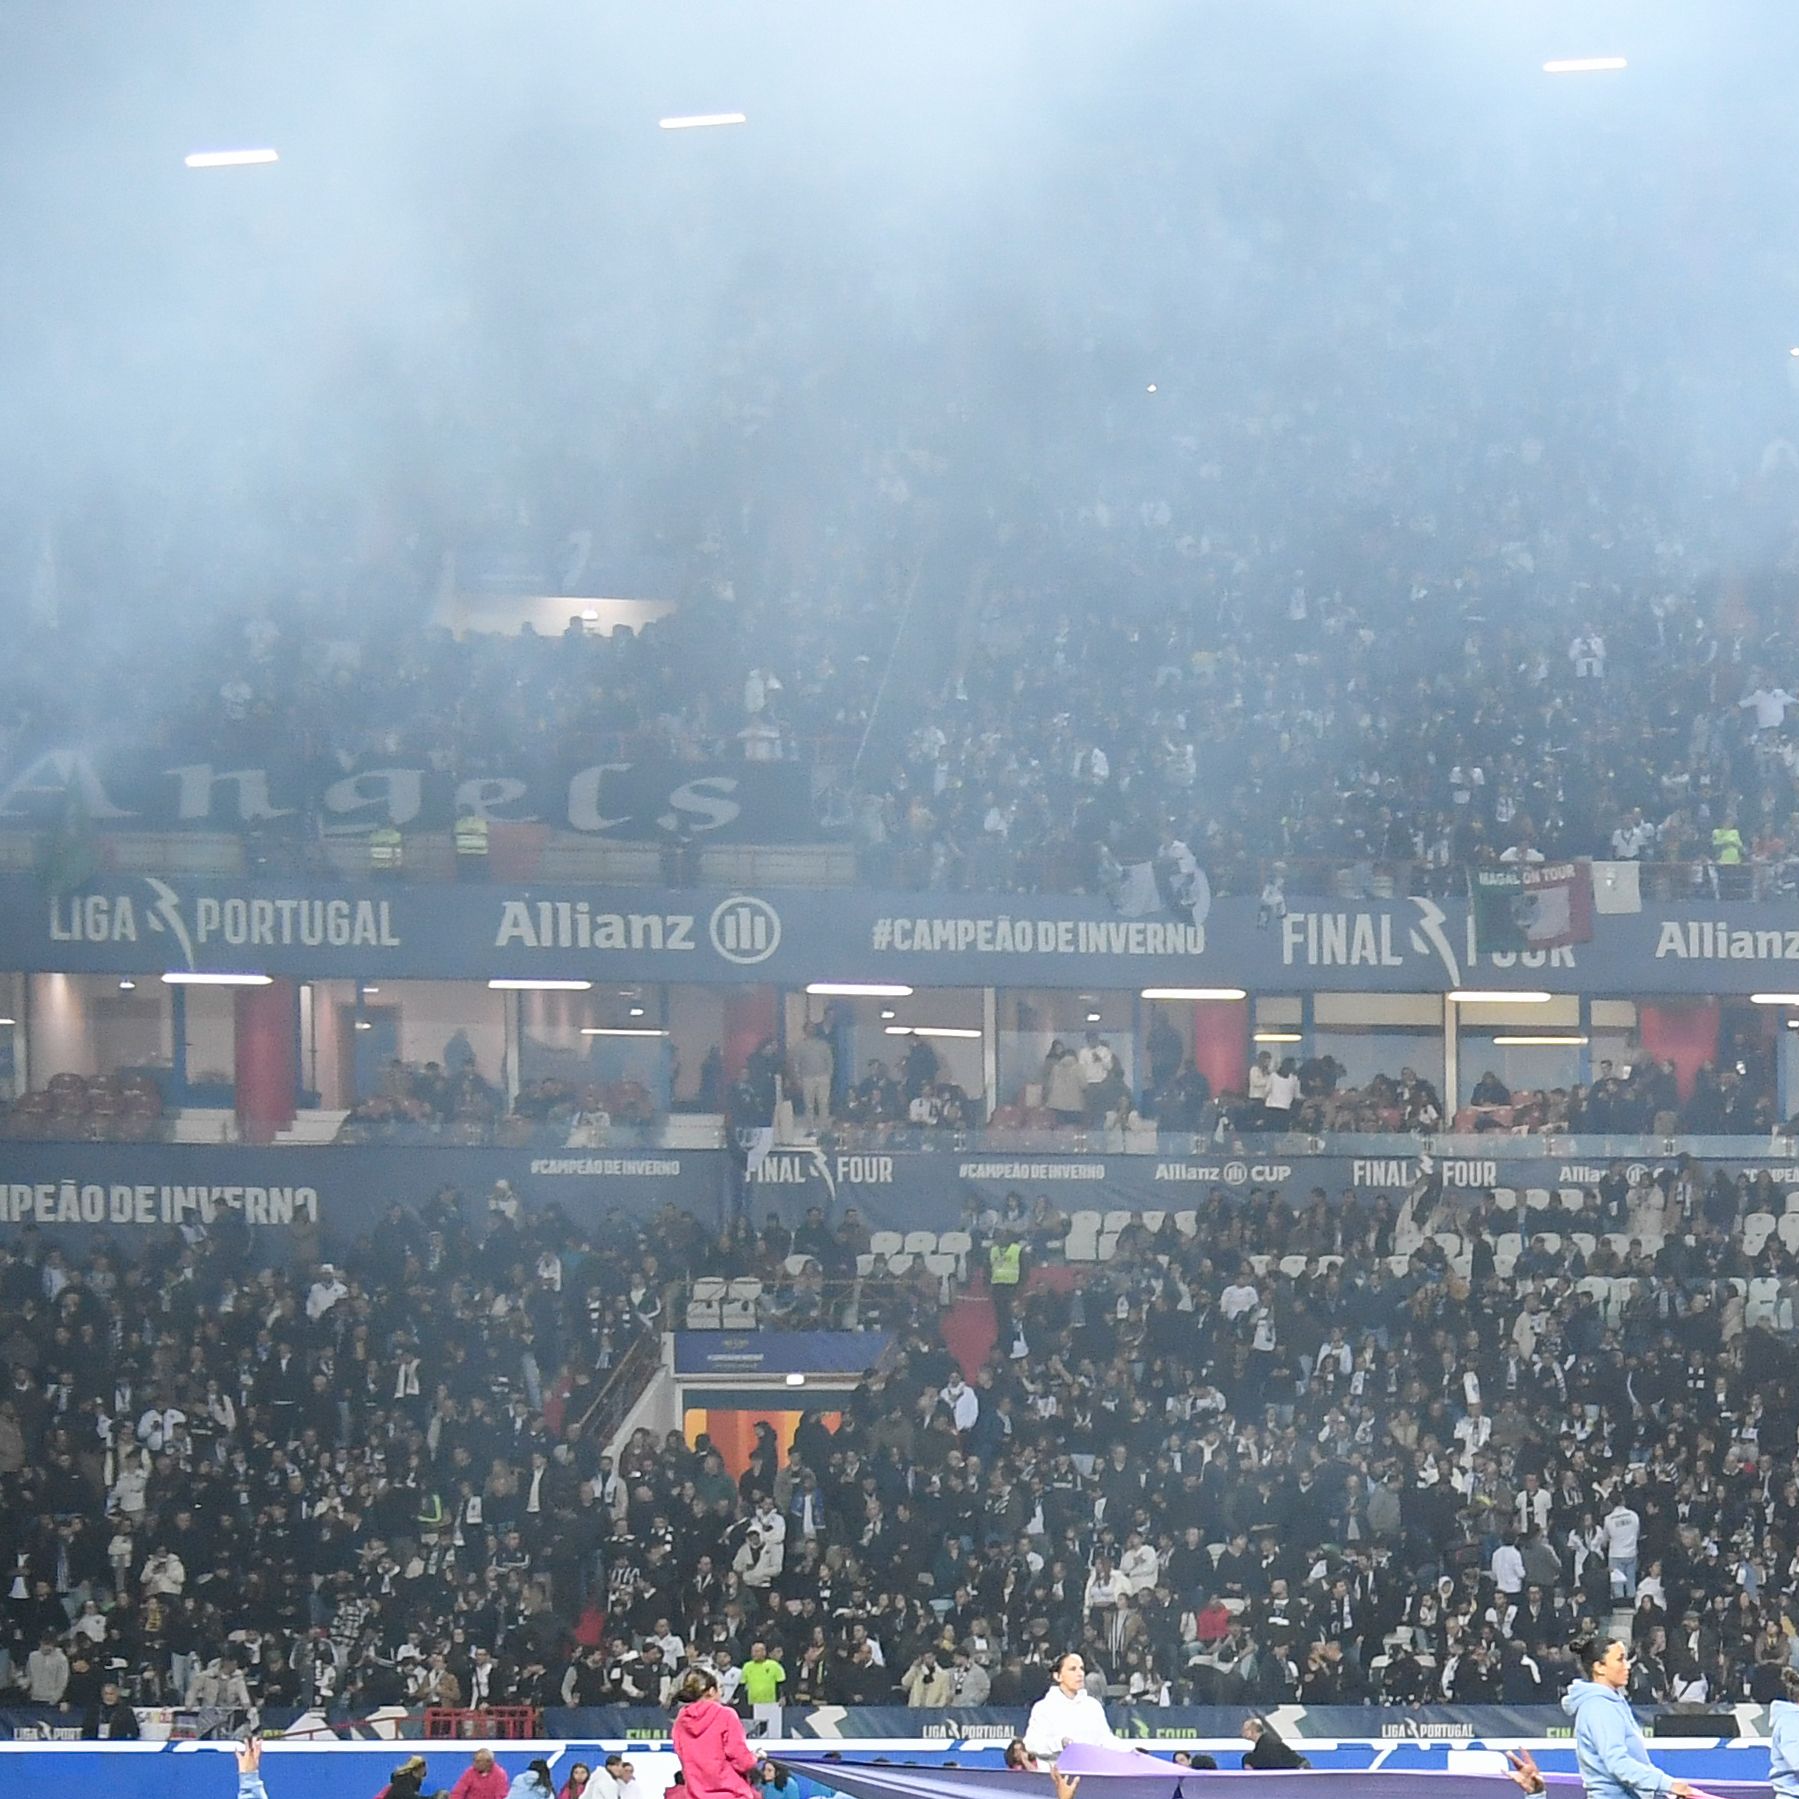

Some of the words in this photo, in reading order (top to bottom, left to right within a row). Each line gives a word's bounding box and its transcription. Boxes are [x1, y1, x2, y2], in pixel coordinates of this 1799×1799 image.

[51, 897, 136, 944] LIGA
[198, 898, 400, 947] PORTUGAL
[495, 902, 695, 952] Allianz
[1281, 913, 1402, 966] FINAL
[837, 1156, 893, 1183] FOUR
[1155, 1164, 1219, 1181] Allianz
[1250, 1166, 1291, 1181] CUP
[1353, 1161, 1409, 1186] FINAL
[1443, 1161, 1497, 1186] FOUR
[1559, 1166, 1603, 1182] Allia
[923, 1725, 946, 1738] LIGA
[961, 1725, 1015, 1738] PORTUGAL
[1382, 1724, 1405, 1738] LIGA
[1420, 1724, 1473, 1738] PORTUGAL
